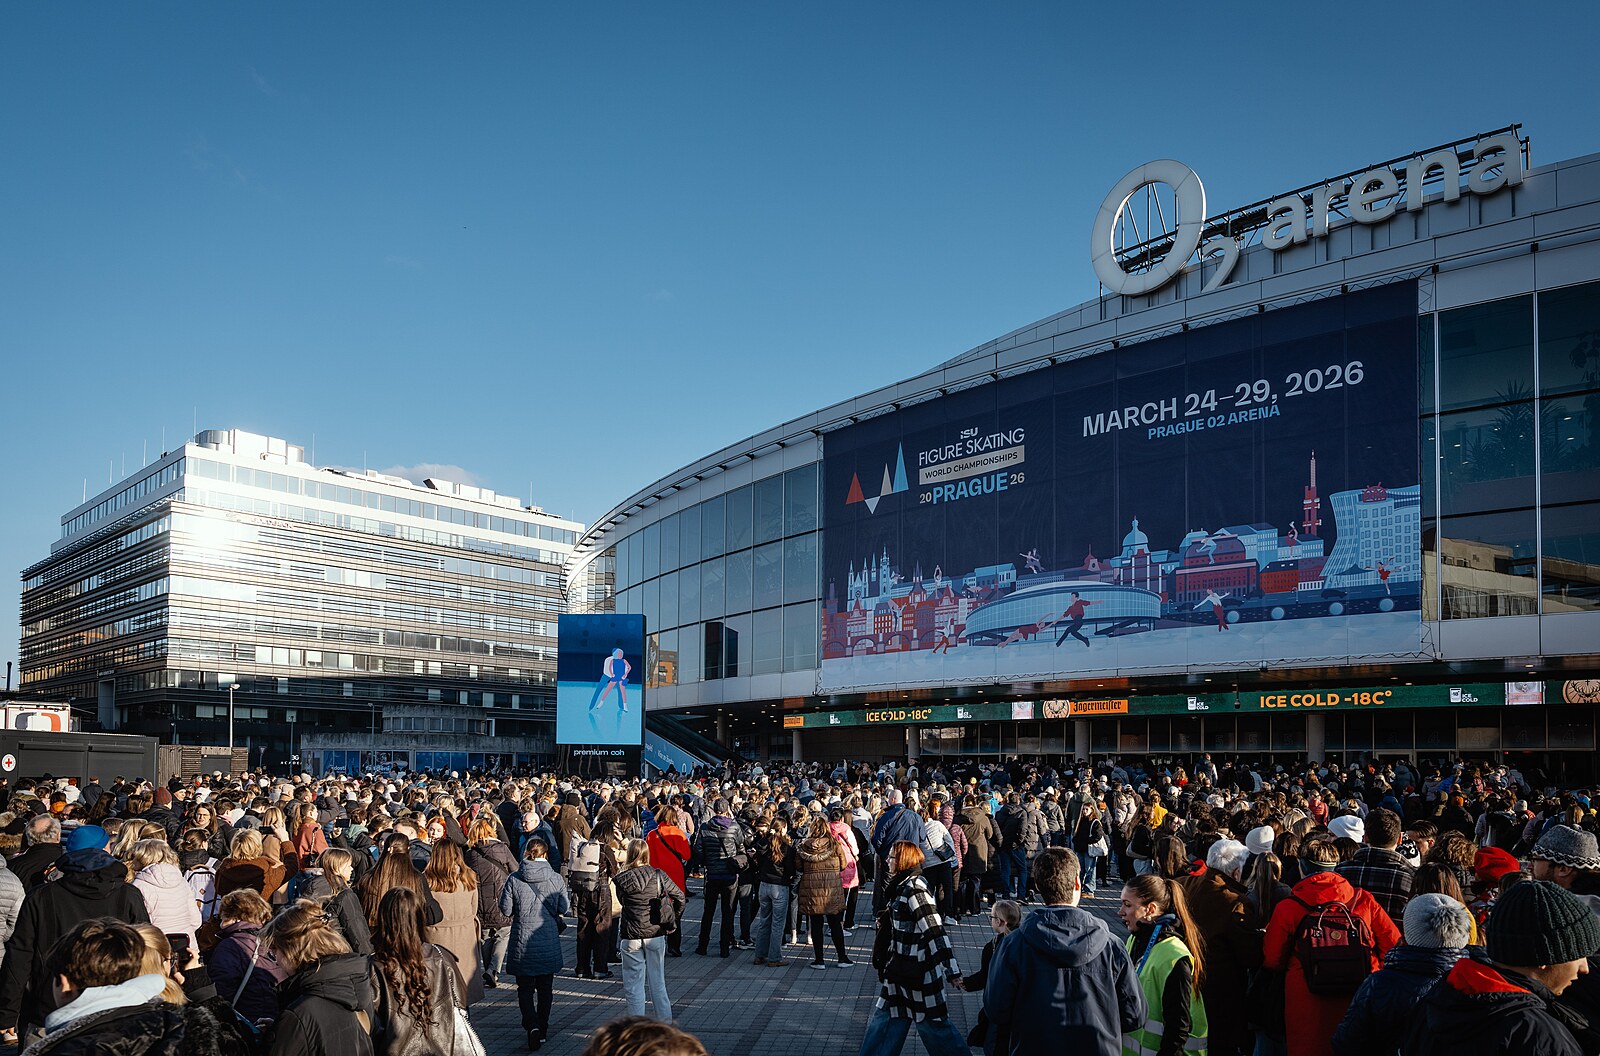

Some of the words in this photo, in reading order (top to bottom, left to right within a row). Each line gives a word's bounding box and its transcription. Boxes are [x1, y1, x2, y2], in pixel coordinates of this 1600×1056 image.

[1262, 134, 1523, 251] arena
[1083, 397, 1177, 437] MARCH
[1285, 361, 1364, 397] 2026
[1148, 418, 1205, 440] PRAGUE
[1227, 404, 1280, 425] ARENA
[919, 442, 963, 466] FIGURE
[966, 428, 1025, 455] SKATING
[925, 467, 952, 479] WORLD
[953, 452, 1018, 473] CHAMPIONSHIPS
[919, 492, 932, 504] 20
[932, 472, 1008, 505] PRAGUE
[1010, 472, 1025, 485] 26
[866, 712, 880, 722] ICE
[1260, 696, 1287, 708] ICE
[1290, 693, 1340, 707] COLD
[573, 749, 609, 757] premium
